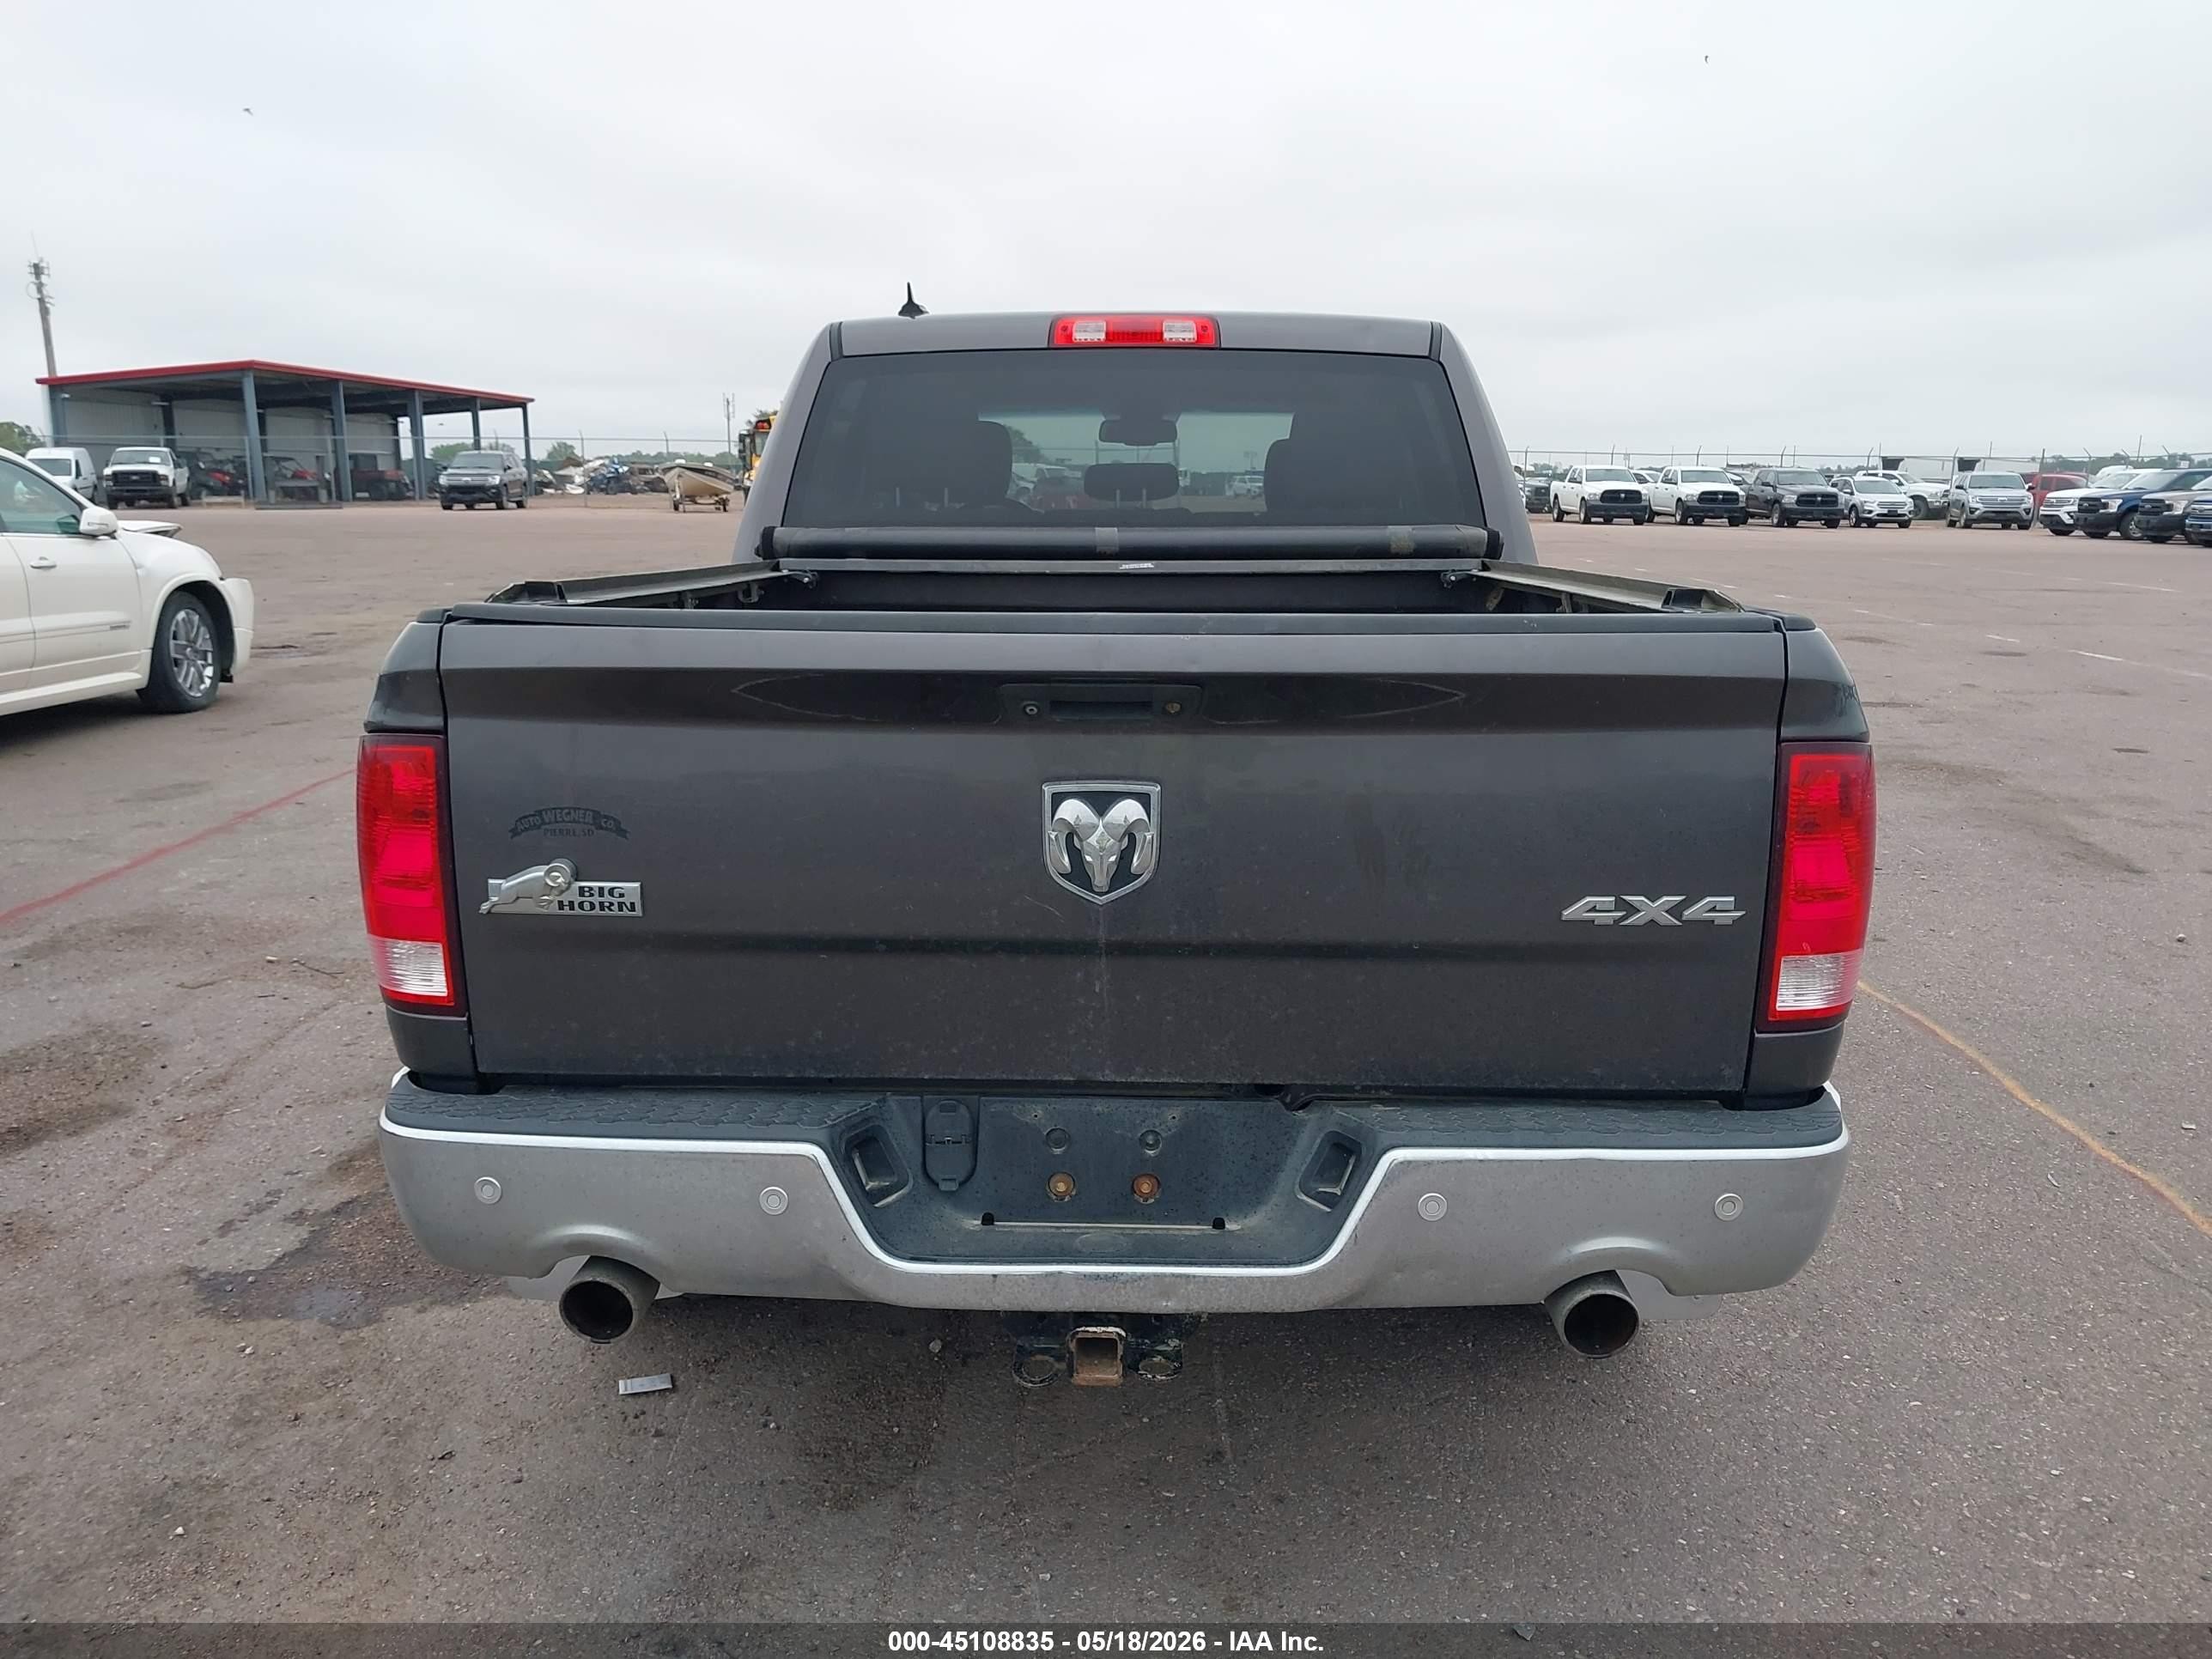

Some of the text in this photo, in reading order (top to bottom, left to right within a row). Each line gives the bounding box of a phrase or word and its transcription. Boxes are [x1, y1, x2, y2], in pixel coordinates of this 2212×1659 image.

[517, 816, 540, 830] AUTO
[542, 808, 593, 823] WEGNER
[581, 828, 594, 837] SD
[578, 885, 625, 899] BIG
[558, 900, 636, 912] HORN
[1561, 896, 1746, 926] 4X4
